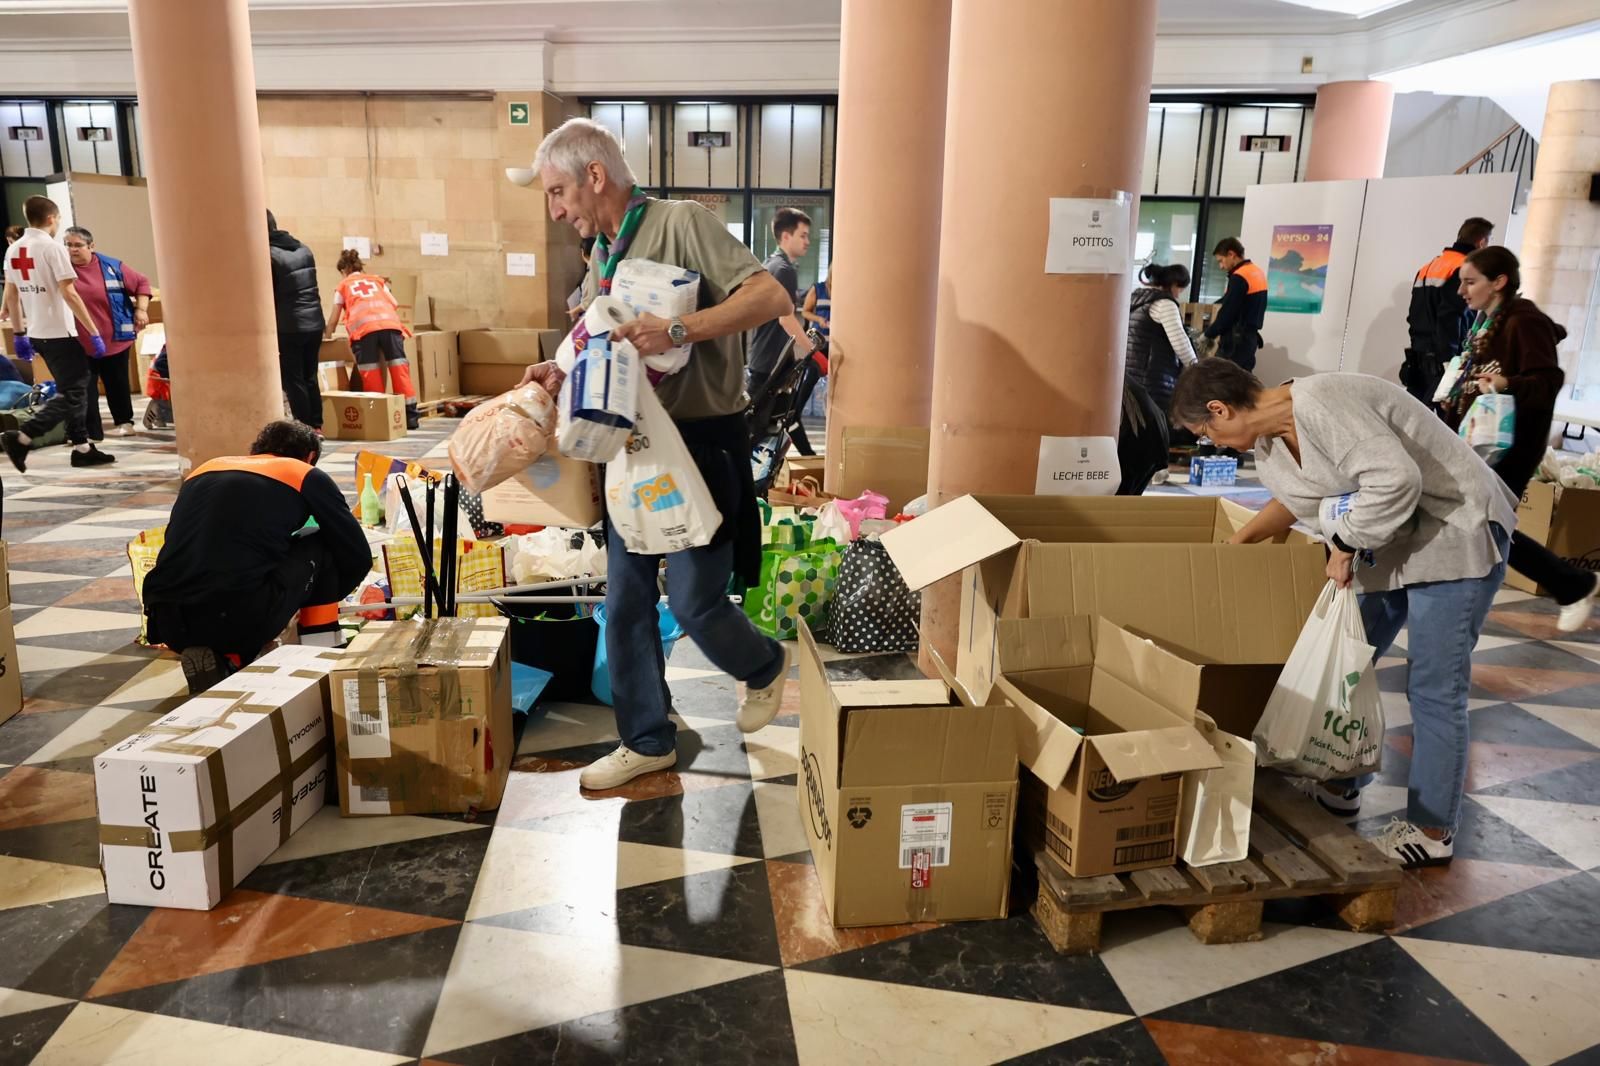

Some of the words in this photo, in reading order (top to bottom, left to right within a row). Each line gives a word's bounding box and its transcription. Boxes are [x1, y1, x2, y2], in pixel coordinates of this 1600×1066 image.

[1073, 236, 1114, 248] POTITOS
[1277, 233, 1310, 242] verso
[1316, 233, 1329, 242] 24
[1053, 471, 1084, 481] LECHE
[1086, 470, 1111, 480] BEBE
[117, 715, 179, 752] CRETE
[272, 769, 328, 824] CREAE
[140, 775, 166, 891] CREATE
